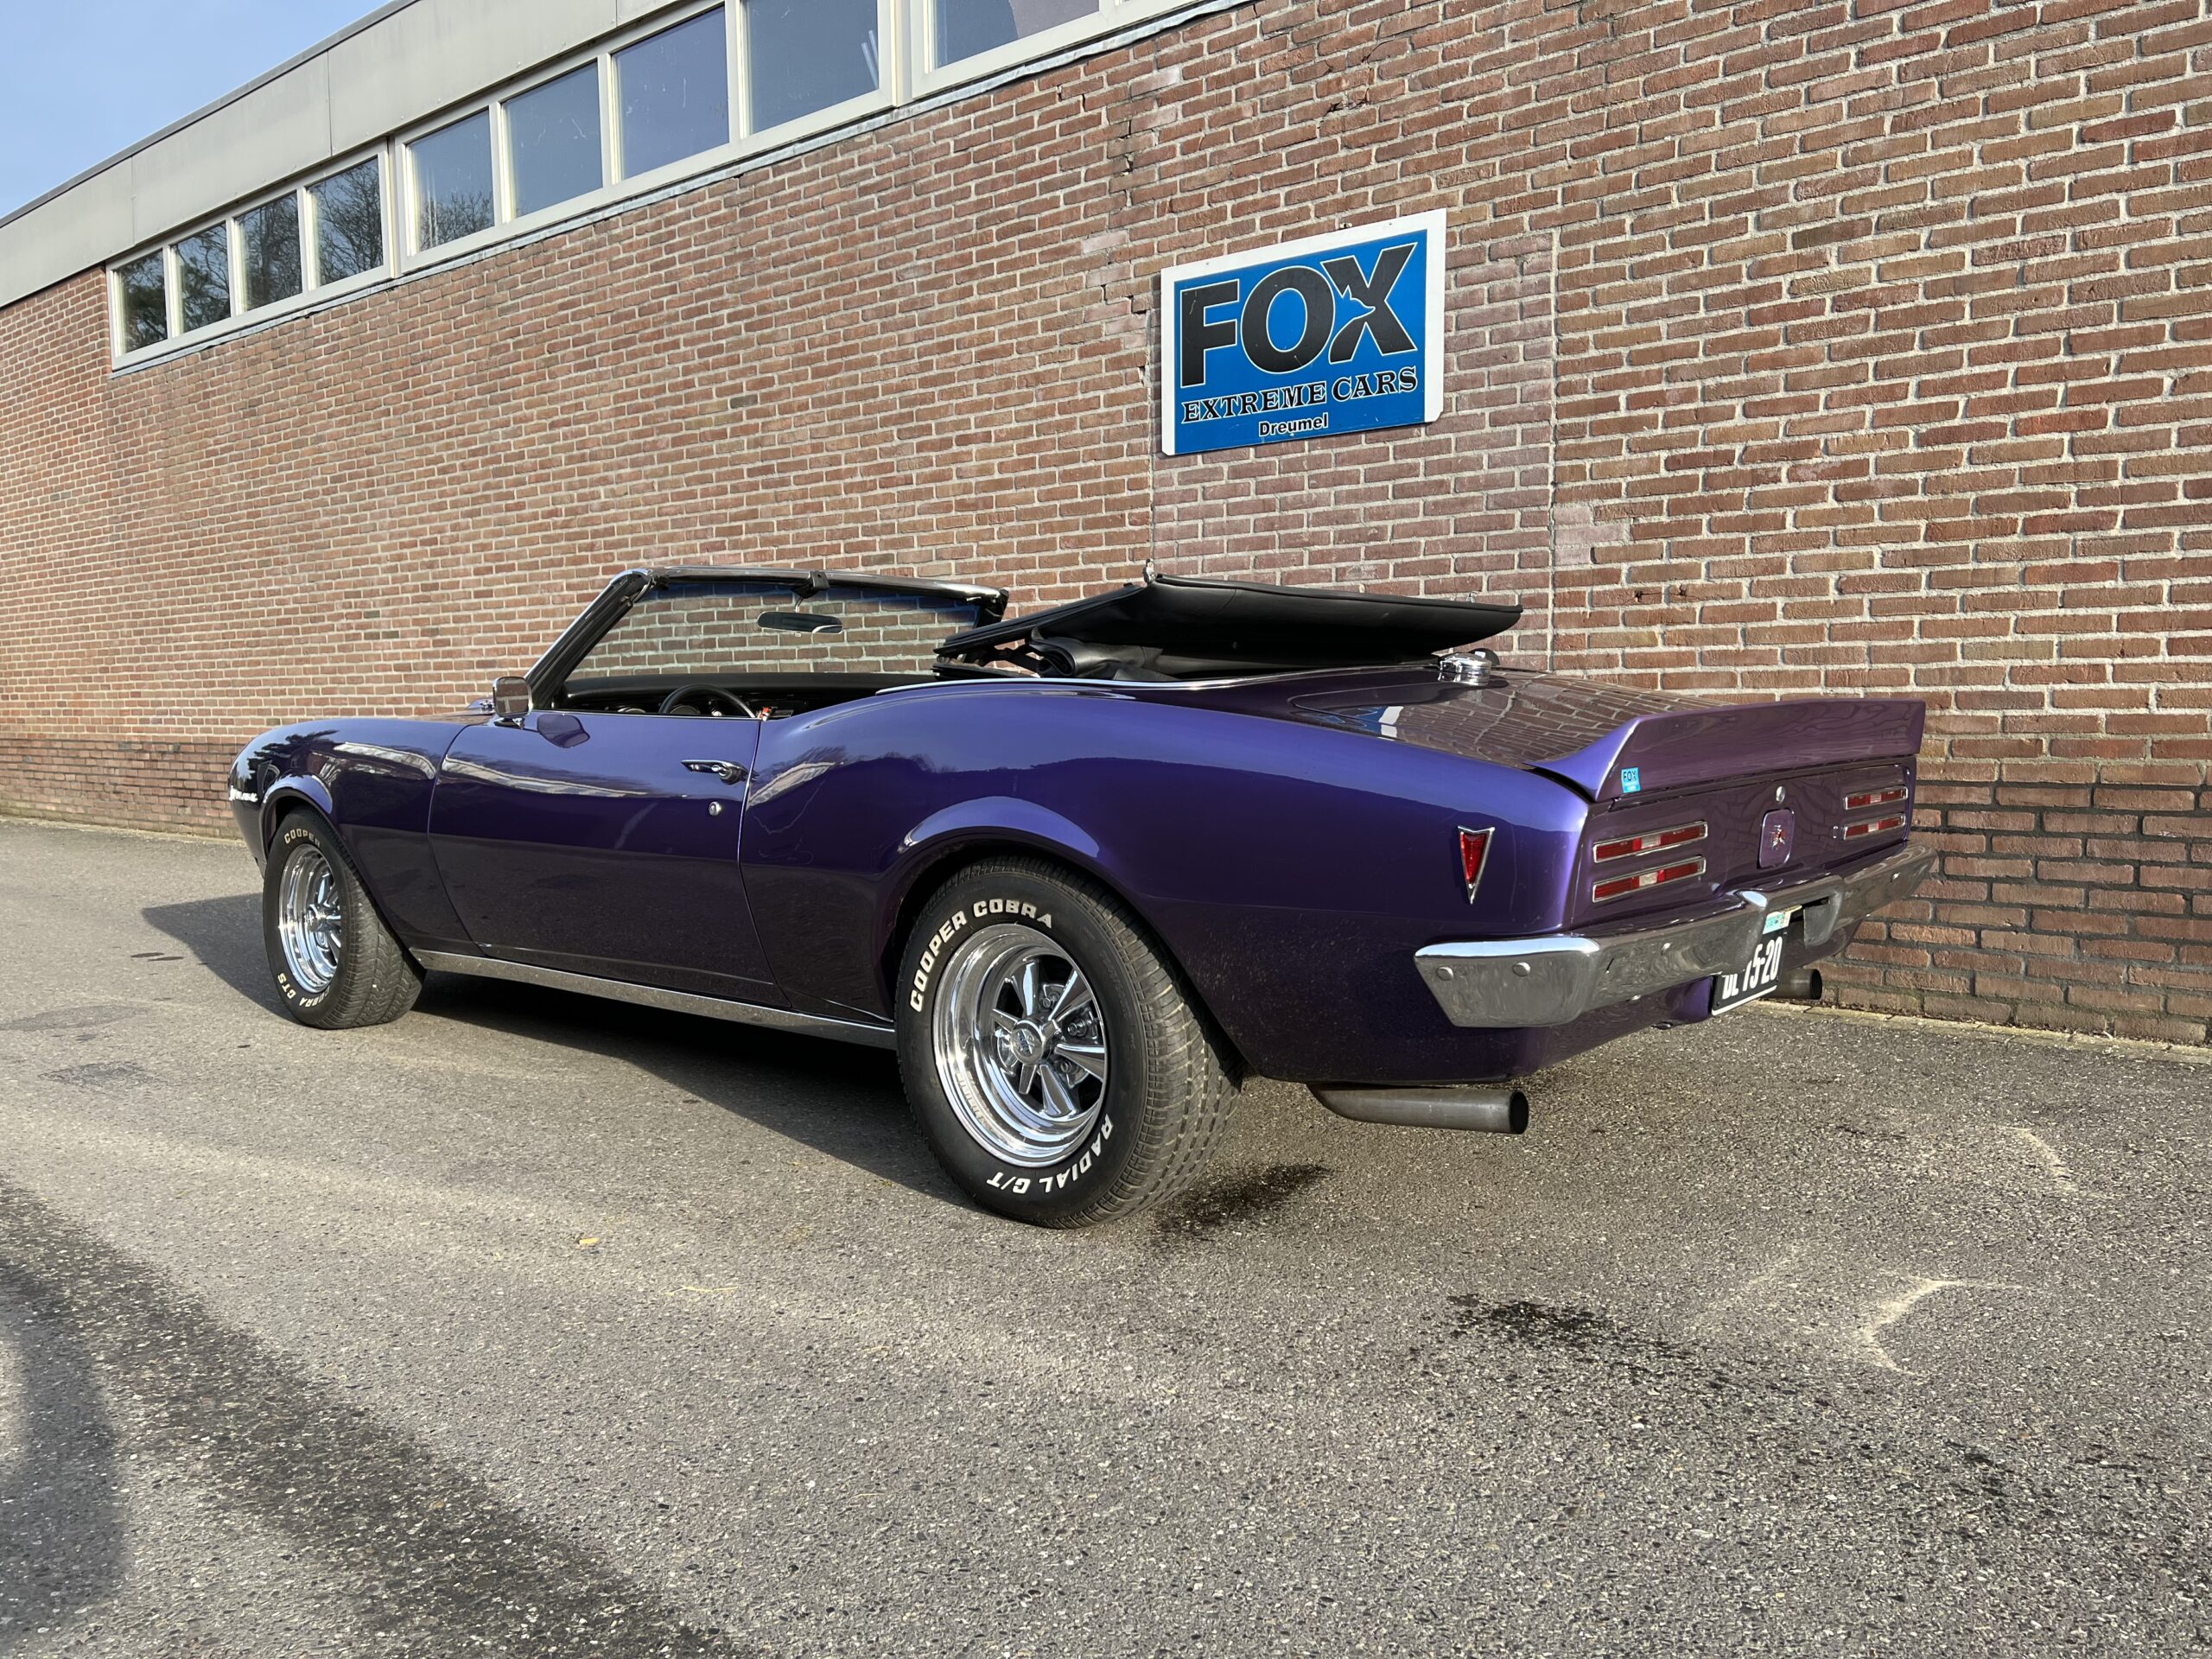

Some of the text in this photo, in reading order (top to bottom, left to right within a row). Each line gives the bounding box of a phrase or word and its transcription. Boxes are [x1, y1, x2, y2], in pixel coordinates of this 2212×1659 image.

[1180, 242, 1418, 389] FOX
[1181, 365, 1418, 424] EXTREME CARS
[1259, 412, 1328, 437] Dreumel
[1623, 771, 1637, 781] FOX
[283, 828, 321, 848] COOPER
[910, 898, 1052, 1013] COOPER COBRA
[277, 972, 296, 999] GTS
[986, 1114, 1114, 1194] RADIAL G/T
